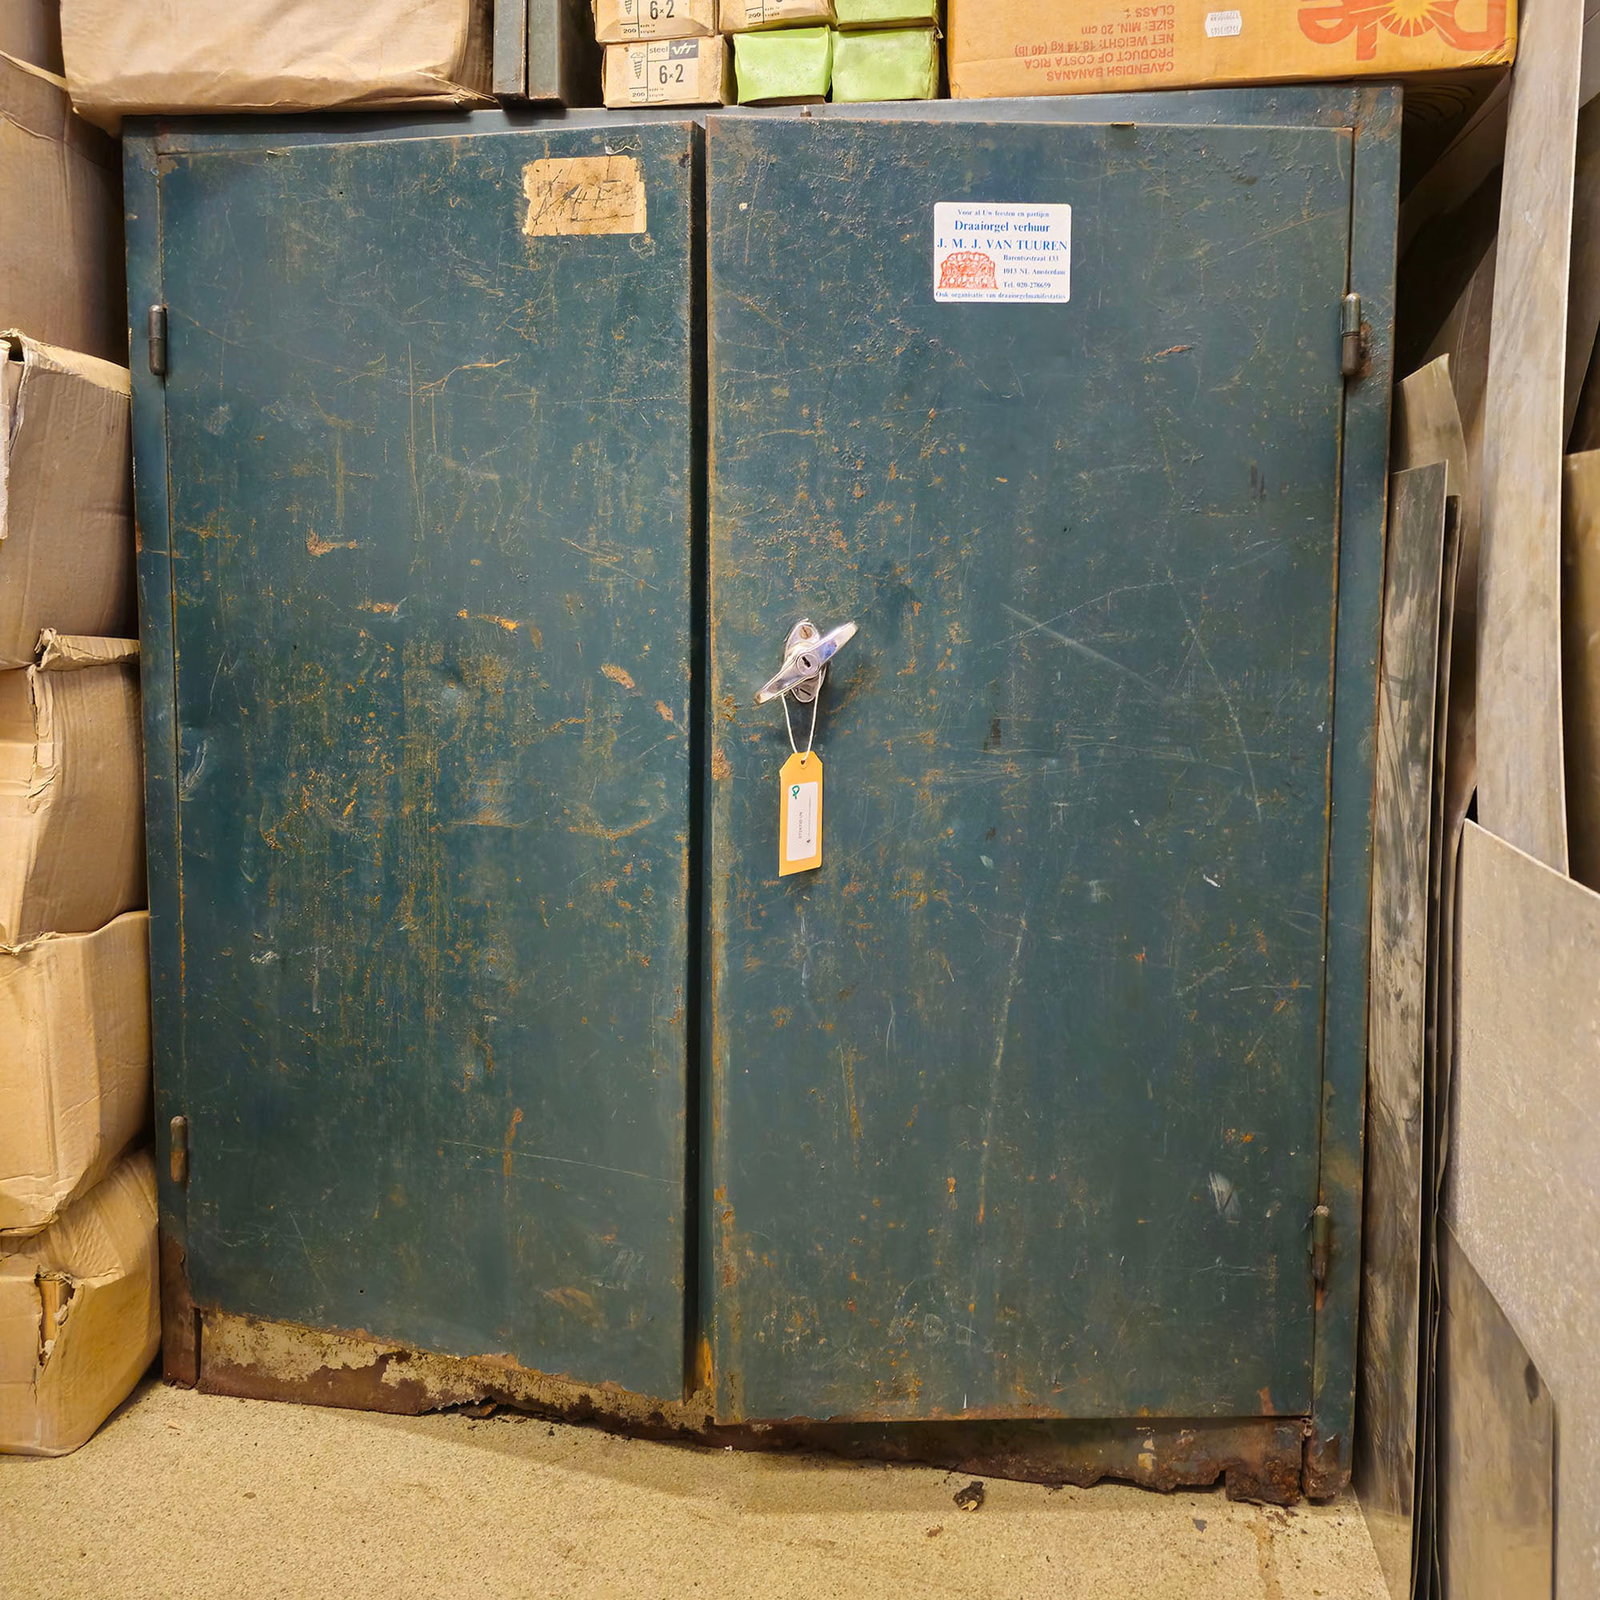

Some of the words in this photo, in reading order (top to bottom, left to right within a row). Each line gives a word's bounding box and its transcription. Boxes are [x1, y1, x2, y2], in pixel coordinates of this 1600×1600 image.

[1135, 5, 1174, 18] CLASS
[1081, 26, 1098, 34] cm
[1101, 24, 1114, 34] 20
[1117, 22, 1141, 33] MIN.
[1145, 19, 1174, 31] SIZE:
[1100, 36, 1148, 49] WEIGHT:
[1151, 33, 1174, 46] NET
[649, 46, 668, 54] steel
[1014, 44, 1029, 57] lb)
[1032, 43, 1048, 55] (40
[1051, 41, 1065, 52] kg
[1067, 40, 1095, 52] 18.14
[1055, 54, 1095, 66] COSTA
[1098, 52, 1114, 63] OF
[1117, 47, 1174, 61] PRODUCT
[1024, 57, 1051, 69] RICA
[1107, 61, 1174, 75] CAVENDISH
[1046, 67, 1104, 81] BANANAS
[954, 220, 1009, 232] Draaiorgel
[1013, 222, 1051, 232] verhuur
[937, 238, 948, 248] J.
[952, 238, 967, 249] M.
[971, 239, 982, 249] J.
[986, 239, 1012, 249] VAN
[1015, 240, 1067, 250] TUUREN
